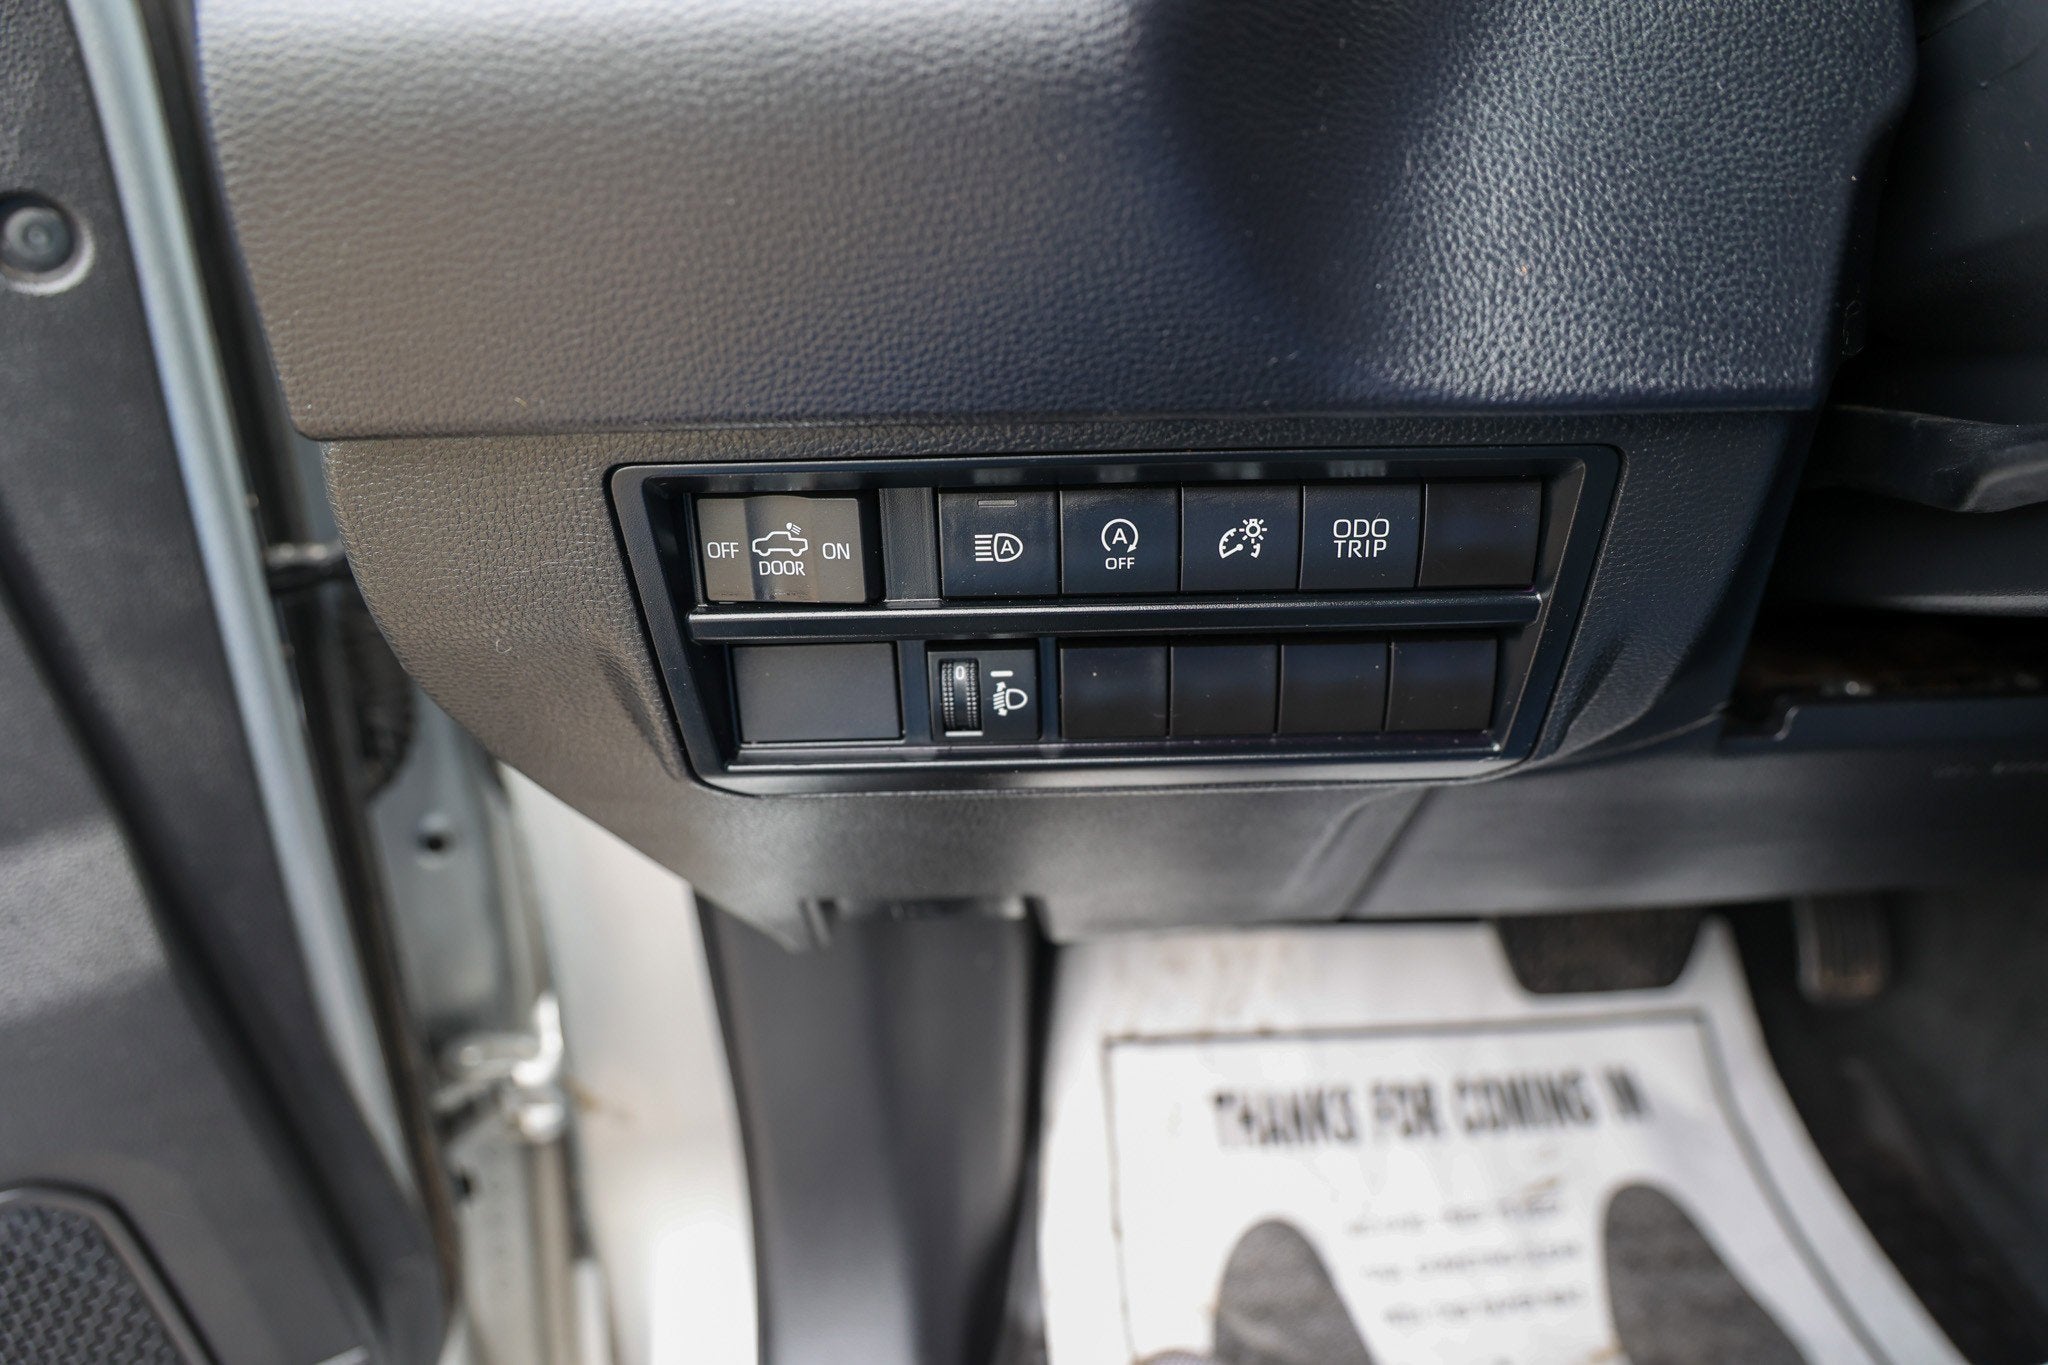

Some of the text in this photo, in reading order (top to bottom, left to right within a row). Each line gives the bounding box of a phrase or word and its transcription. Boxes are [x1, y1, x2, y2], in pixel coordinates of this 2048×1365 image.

[1112, 528, 1128, 545] A
[1333, 518, 1390, 538] ODO
[707, 542, 740, 559] OFF
[822, 543, 851, 560] ON
[1000, 539, 1015, 555] A
[1333, 539, 1387, 559] TRIP
[759, 561, 806, 576] DOOR
[1104, 557, 1135, 570] OFF
[1212, 1088, 1357, 1148] THANKS
[1369, 1080, 1440, 1138] FOR
[1453, 1066, 1596, 1136] COMING
